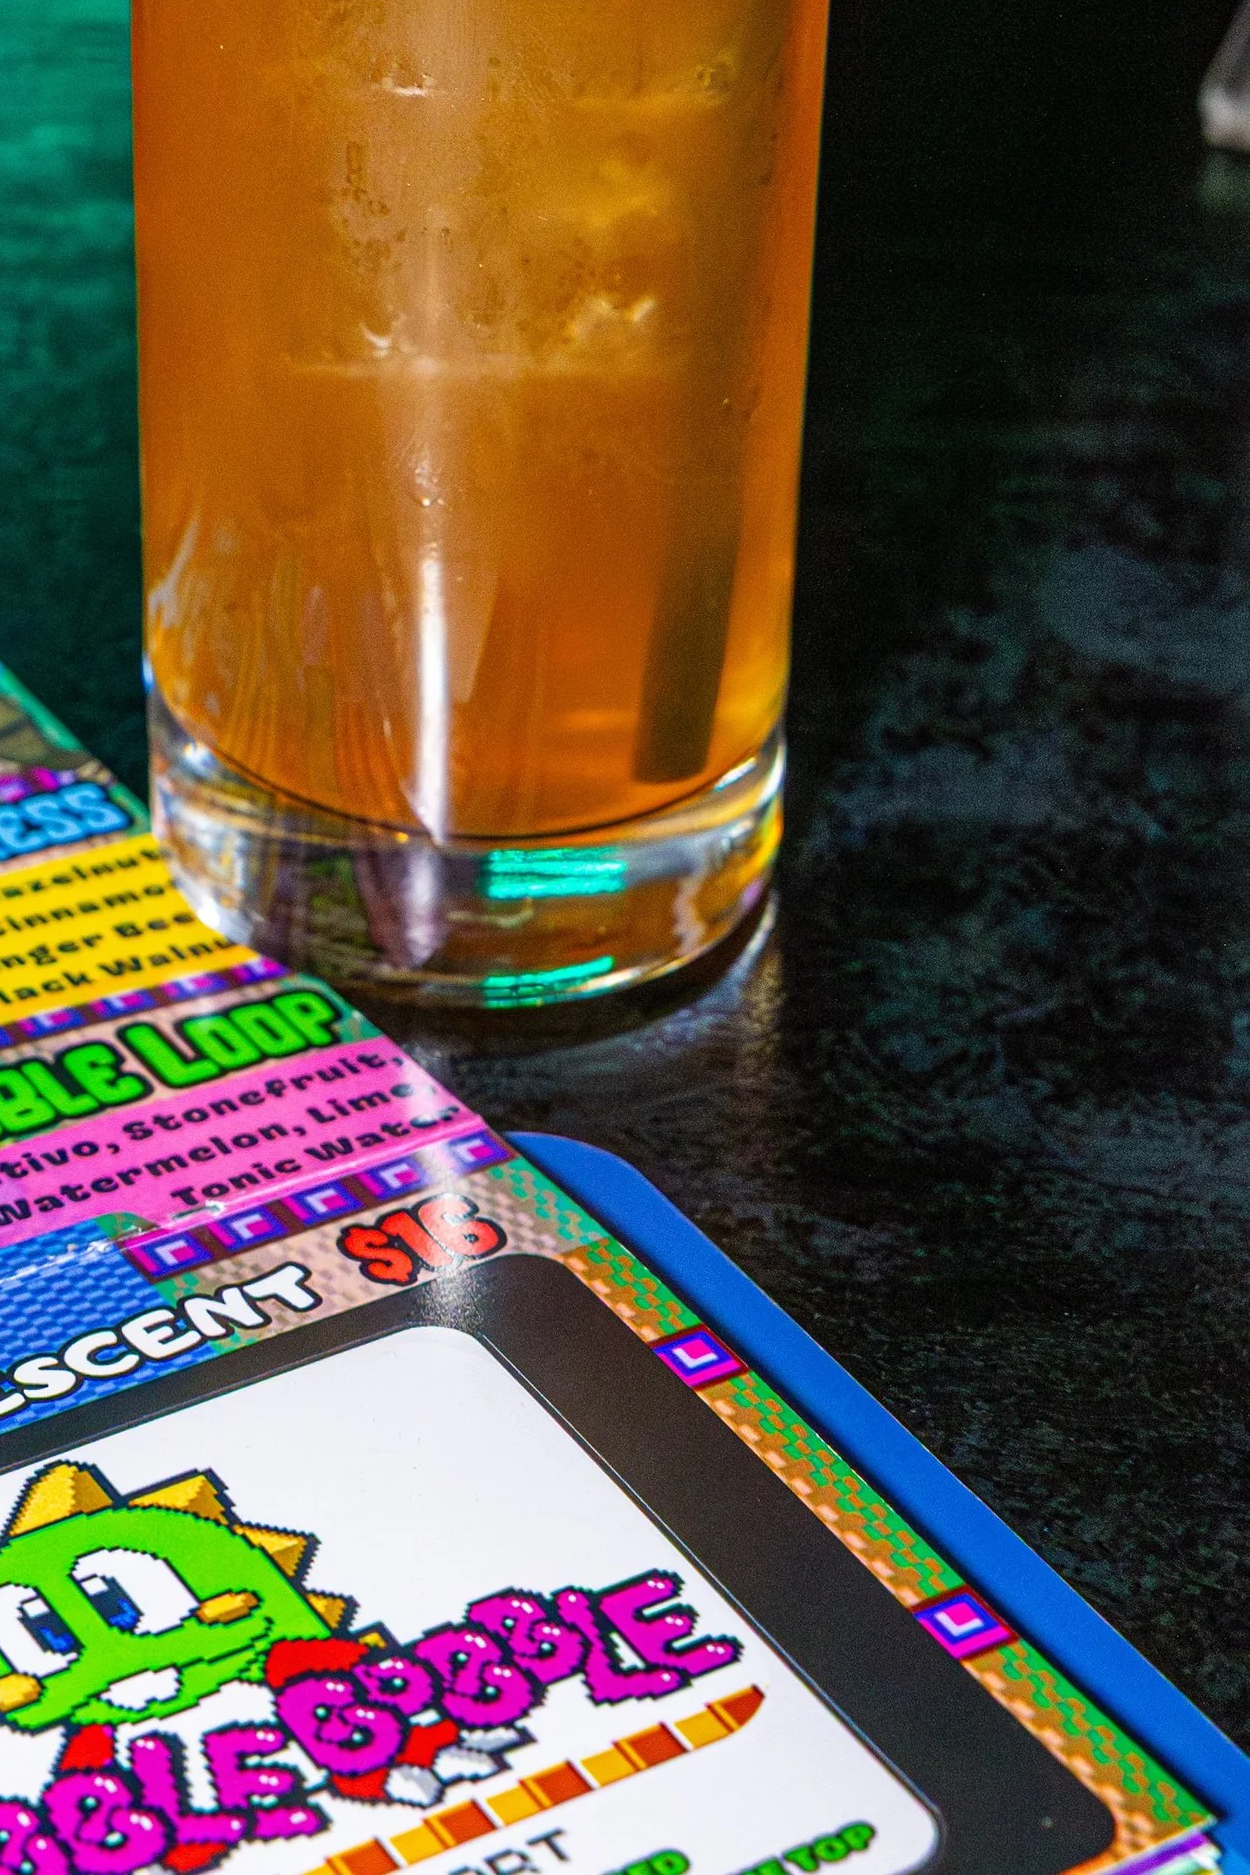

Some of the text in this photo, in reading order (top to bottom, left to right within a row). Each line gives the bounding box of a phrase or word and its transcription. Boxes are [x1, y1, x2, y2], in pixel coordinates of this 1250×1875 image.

[124, 992, 336, 1085] LOOP
[123, 1053, 404, 1142] Stonefruit,
[169, 1106, 460, 1207] Tonic Water
[339, 1193, 506, 1284] $16
[272, 1569, 743, 1778] BOBBLE
